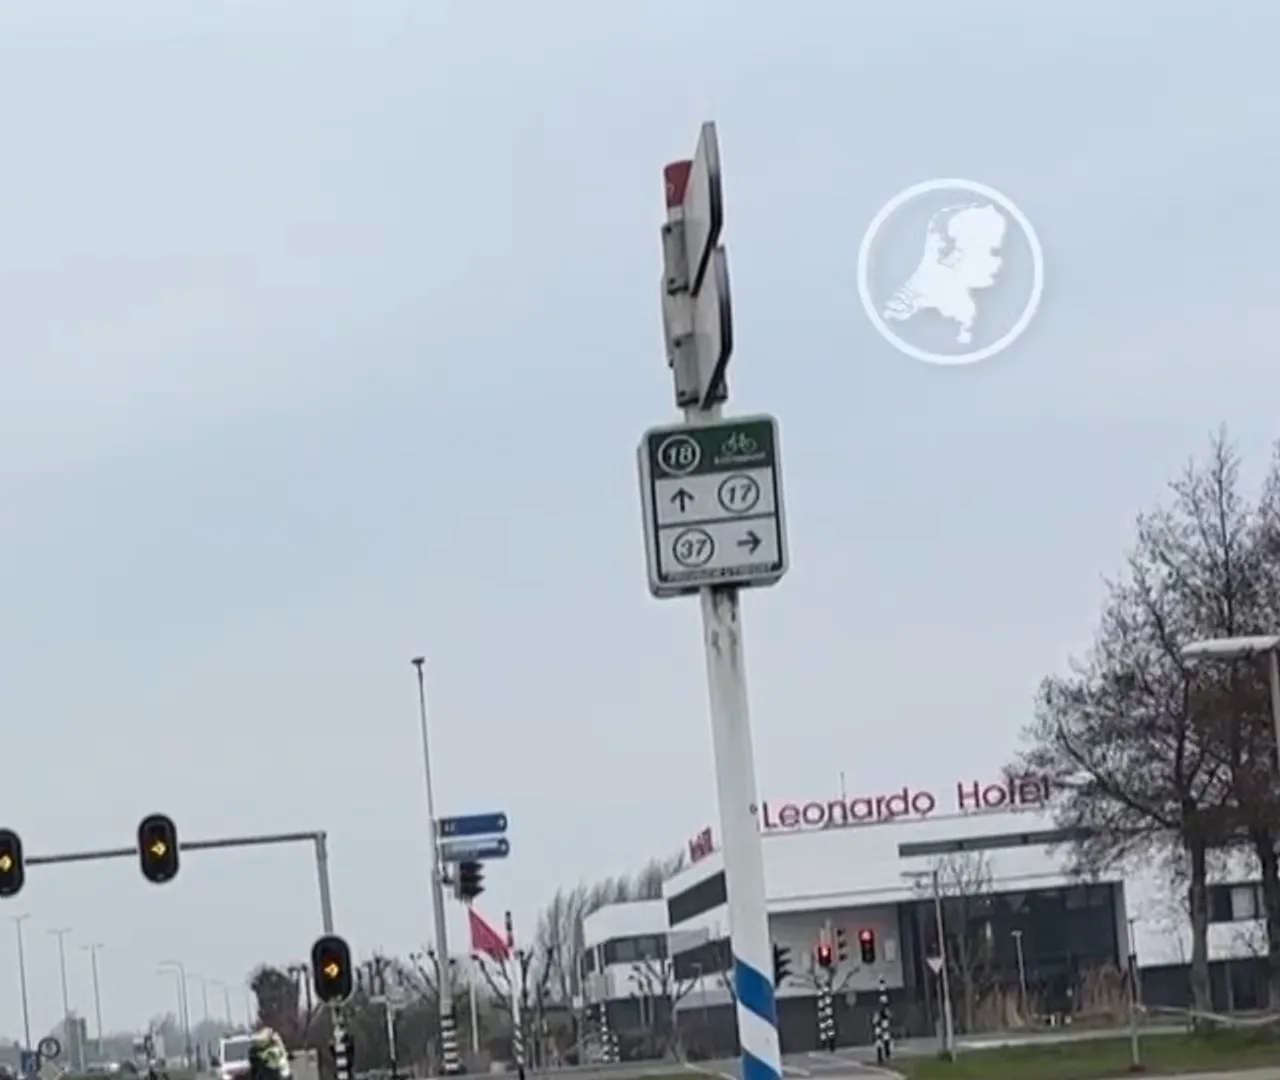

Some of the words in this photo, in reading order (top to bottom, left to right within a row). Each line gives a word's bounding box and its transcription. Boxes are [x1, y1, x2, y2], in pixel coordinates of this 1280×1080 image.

[669, 444, 692, 466] 18
[727, 484, 753, 505] 17
[679, 539, 708, 560] 37
[762, 787, 936, 829] Leonardo
